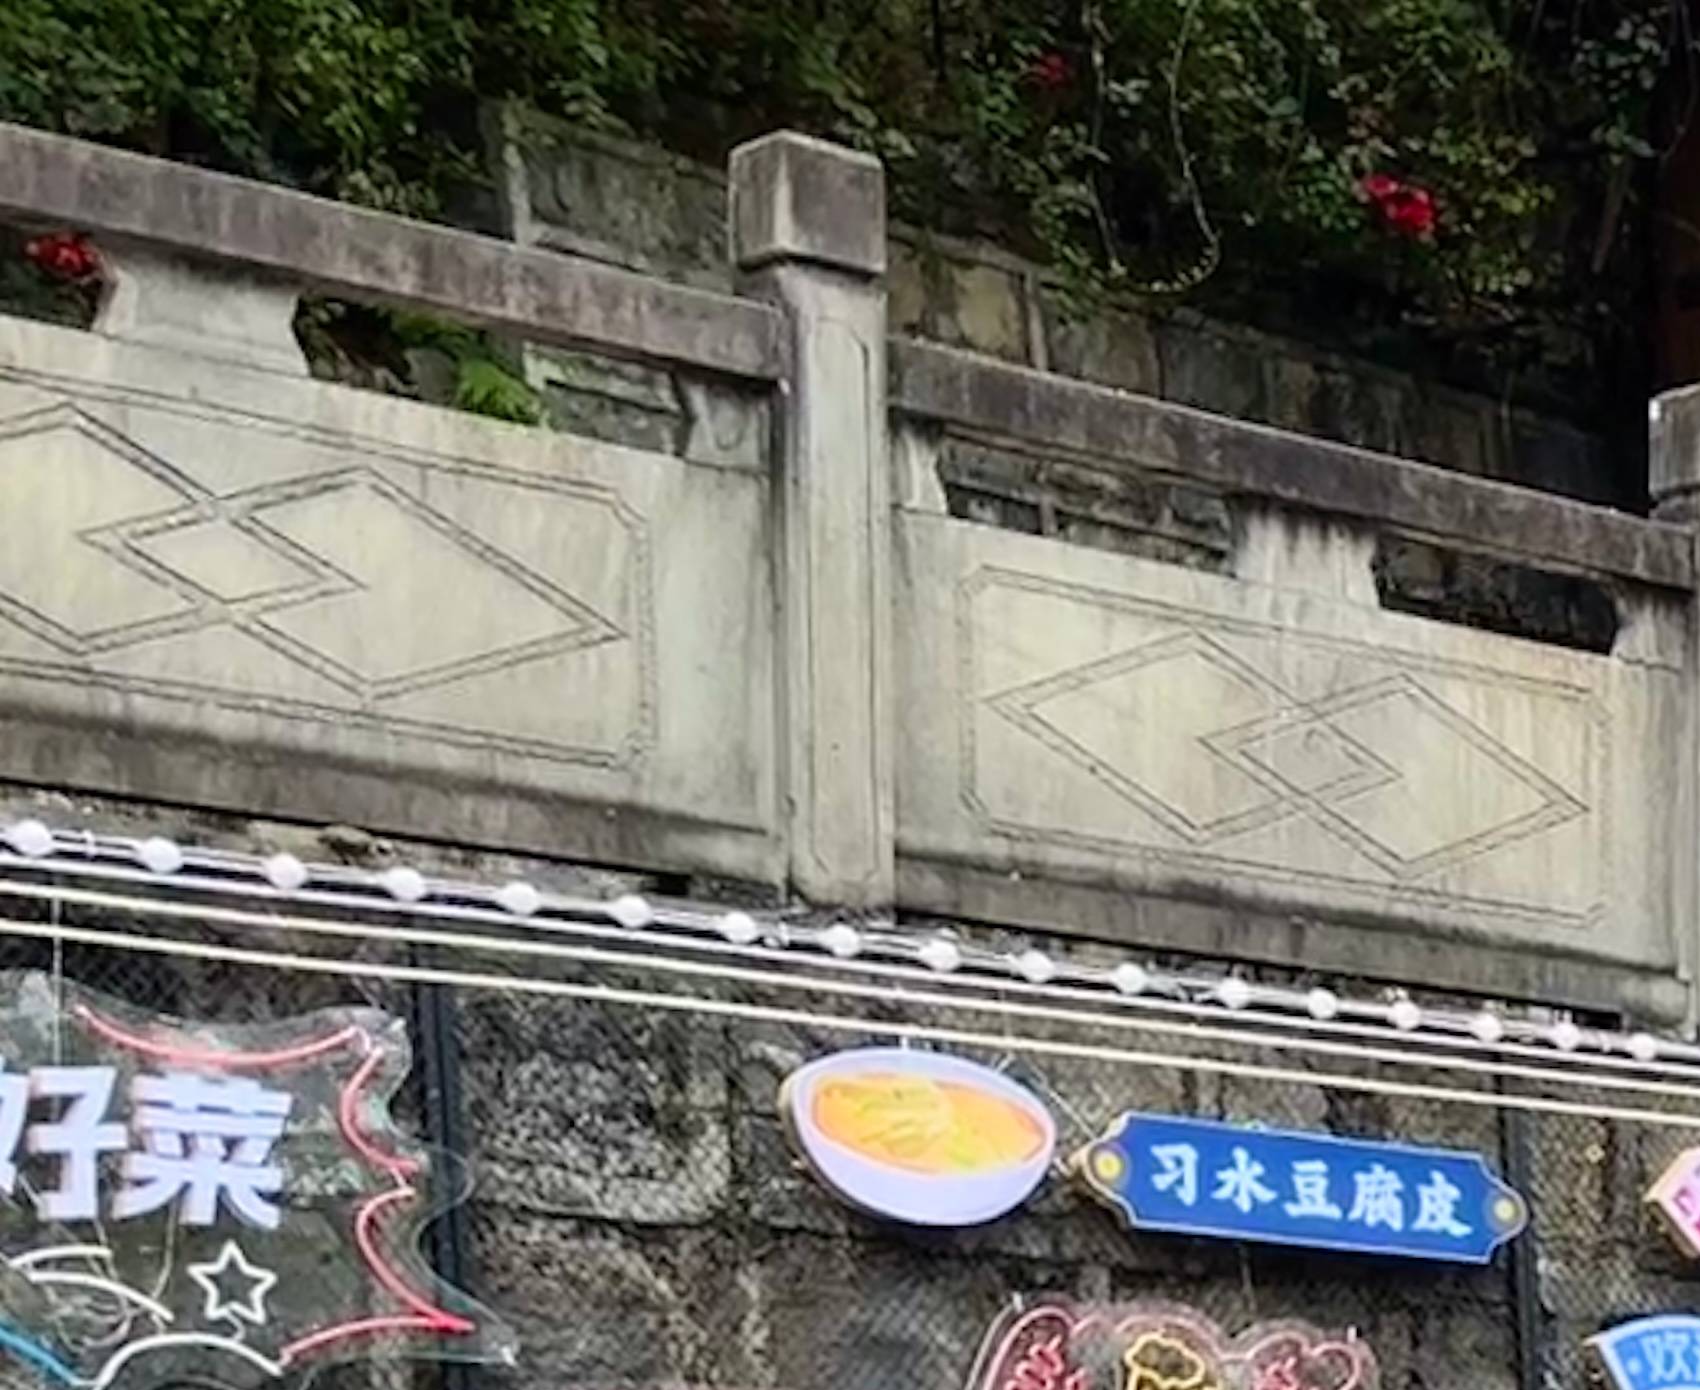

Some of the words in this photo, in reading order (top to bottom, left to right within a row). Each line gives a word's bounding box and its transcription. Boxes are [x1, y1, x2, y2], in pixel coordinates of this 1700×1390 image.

[0, 1058, 293, 1230] 好菜
[1150, 1143, 1473, 1238] 习水豆腐皮
